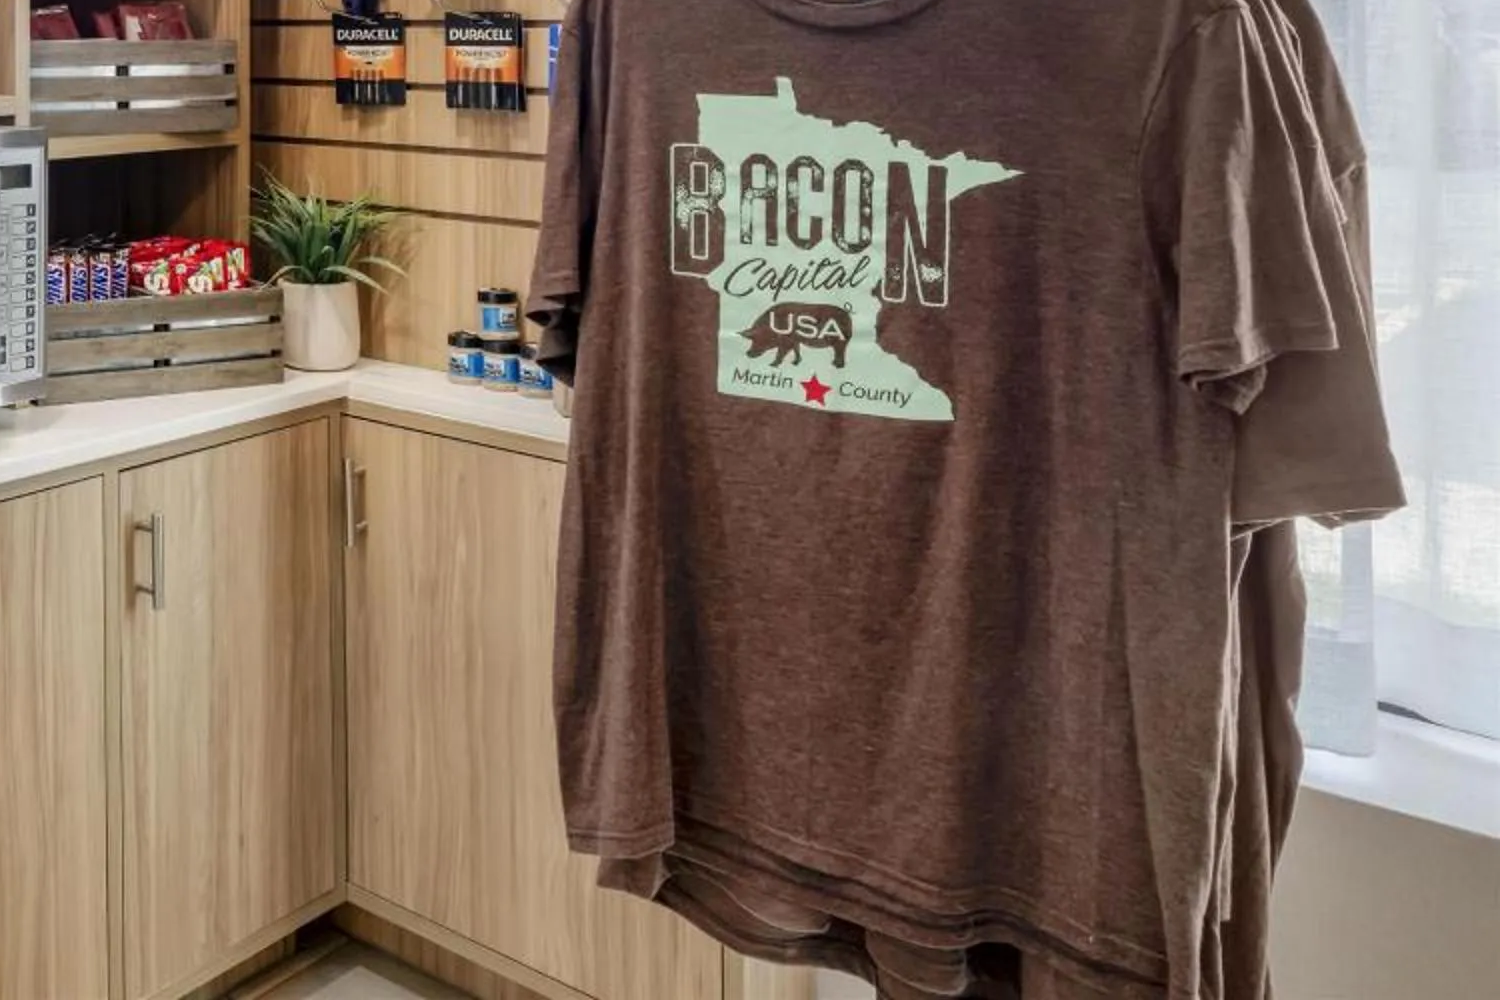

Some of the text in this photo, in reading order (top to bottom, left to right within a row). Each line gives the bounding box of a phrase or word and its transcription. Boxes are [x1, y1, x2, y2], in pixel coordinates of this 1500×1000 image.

[337, 28, 398, 41] DURACELL
[449, 28, 512, 41] DURACELL
[670, 143, 949, 307] BACON
[723, 256, 872, 301] Capital
[769, 311, 845, 341] USA
[731, 367, 912, 409] Martin County
